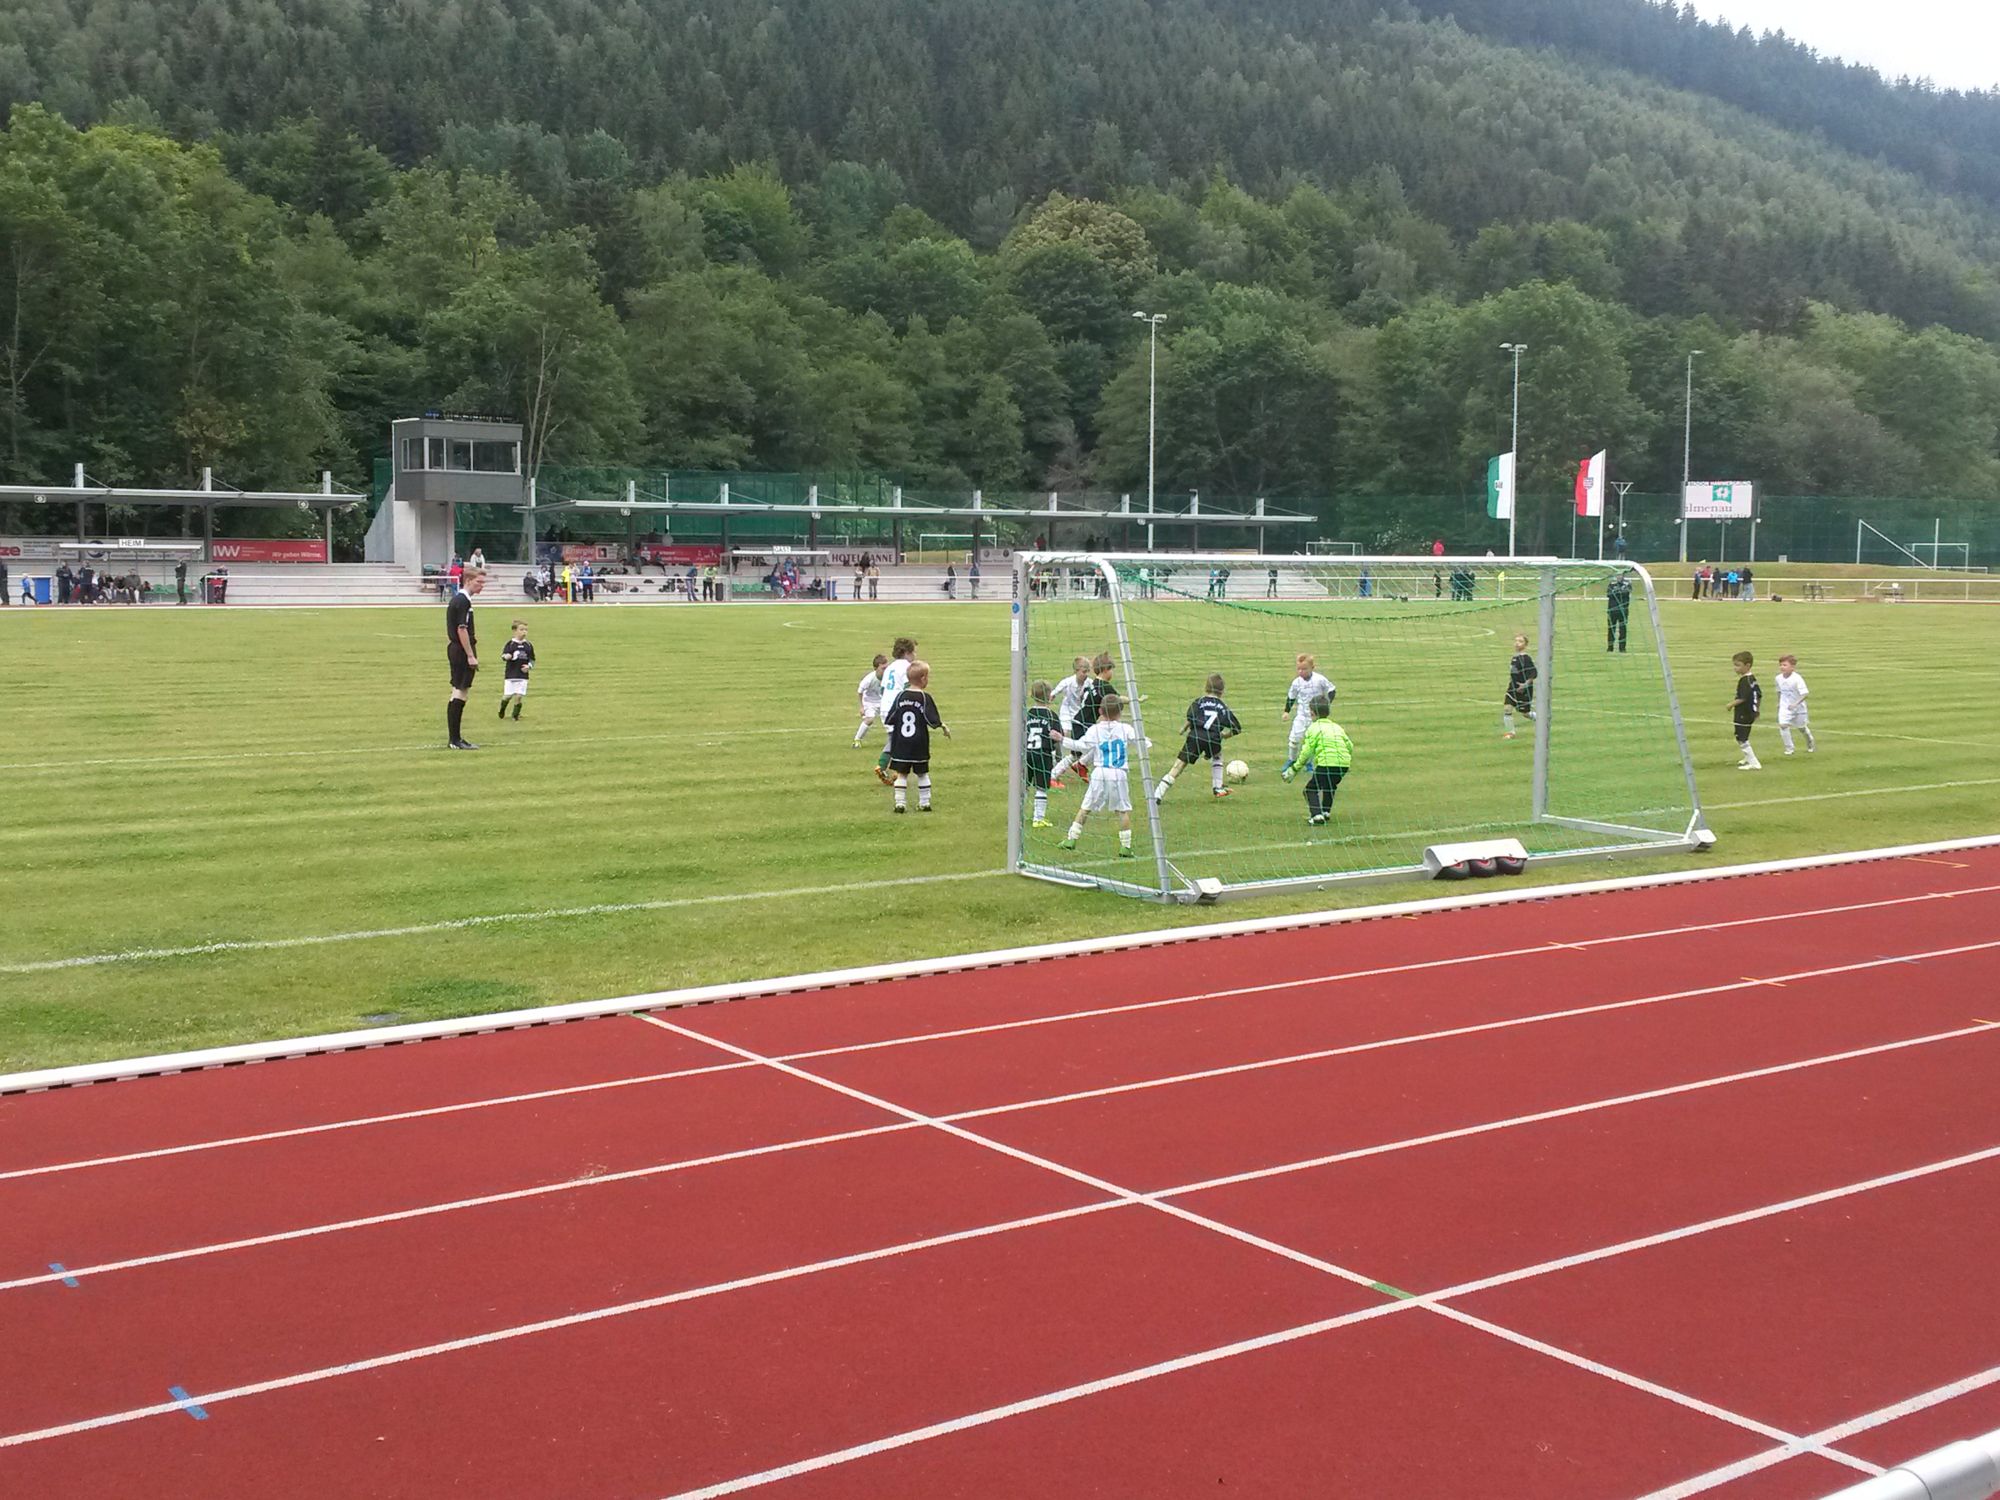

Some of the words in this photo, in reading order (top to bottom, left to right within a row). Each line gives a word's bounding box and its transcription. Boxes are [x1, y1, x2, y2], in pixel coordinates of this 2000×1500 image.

[886, 669, 895, 690] 5
[901, 711, 916, 738] 8
[1203, 710, 1218, 730] 7
[1027, 727, 1043, 750] 5
[1100, 738, 1125, 769] 10
